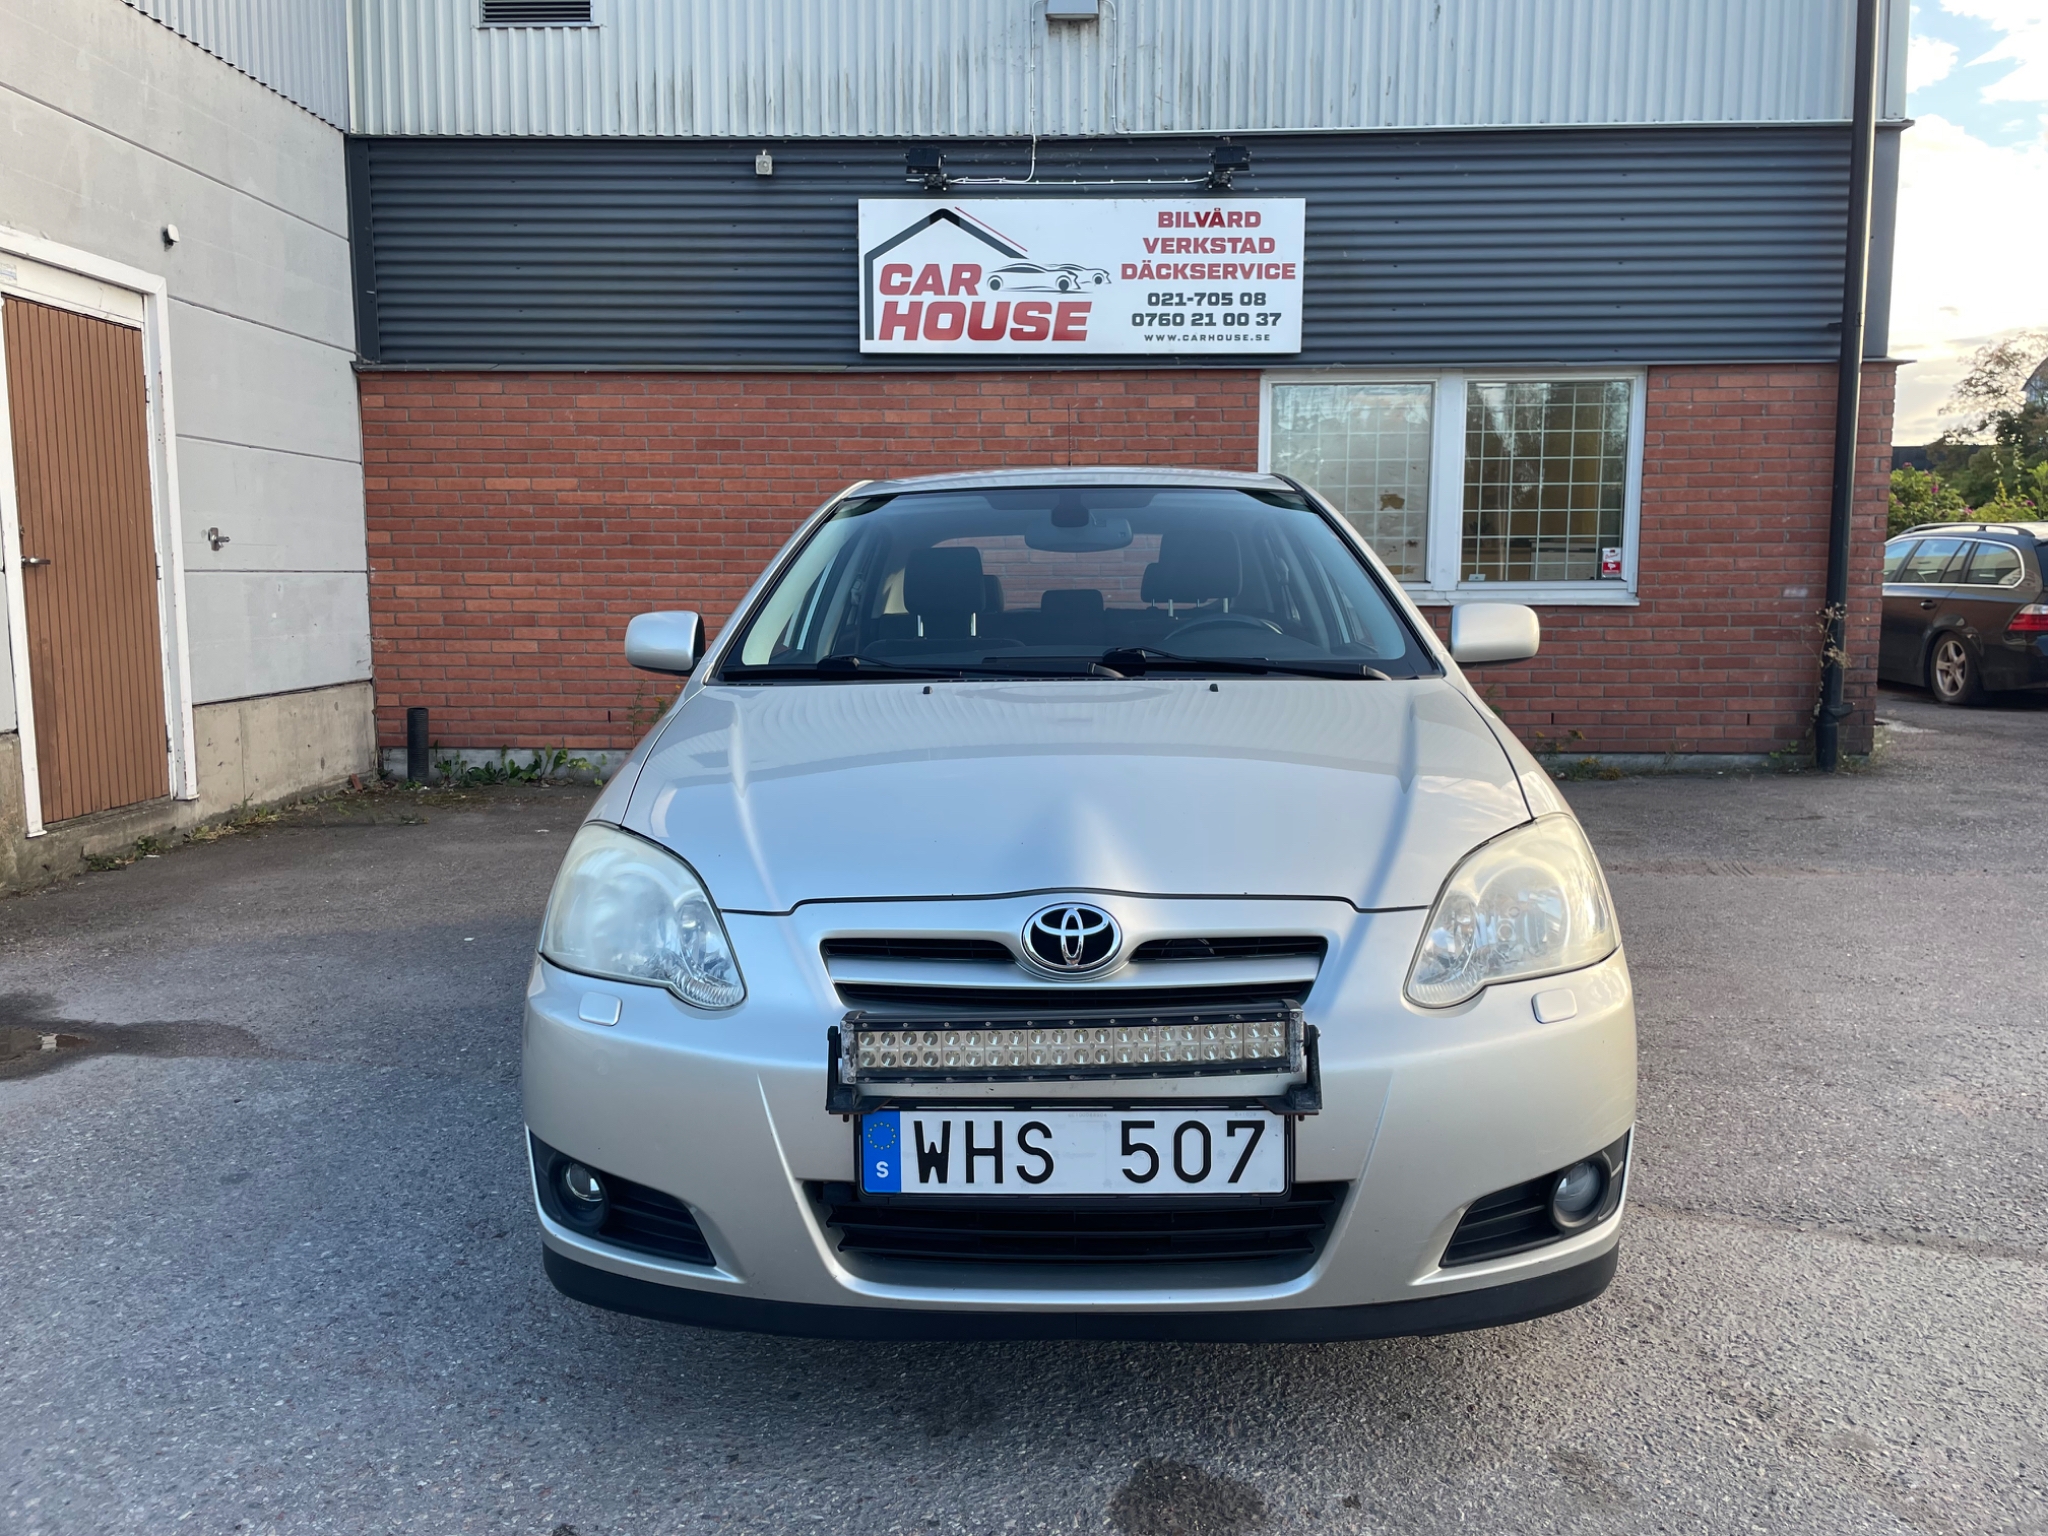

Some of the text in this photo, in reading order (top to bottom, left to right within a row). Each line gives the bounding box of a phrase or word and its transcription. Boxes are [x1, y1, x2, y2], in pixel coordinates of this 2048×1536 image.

[1158, 207, 1262, 228] BILVÅRD
[1142, 237, 1276, 254] VERKSTAD
[878, 263, 983, 296] CAR
[1121, 259, 1296, 280] DÄCKSERVICE
[1147, 292, 1267, 307] 021-705 08
[878, 301, 1093, 342] HOUSE
[1131, 312, 1282, 327] 0760 21 00 37
[1144, 333, 1271, 342] WWW.CARHOUSE.SE
[875, 1120, 1267, 1185] S WHS 507
